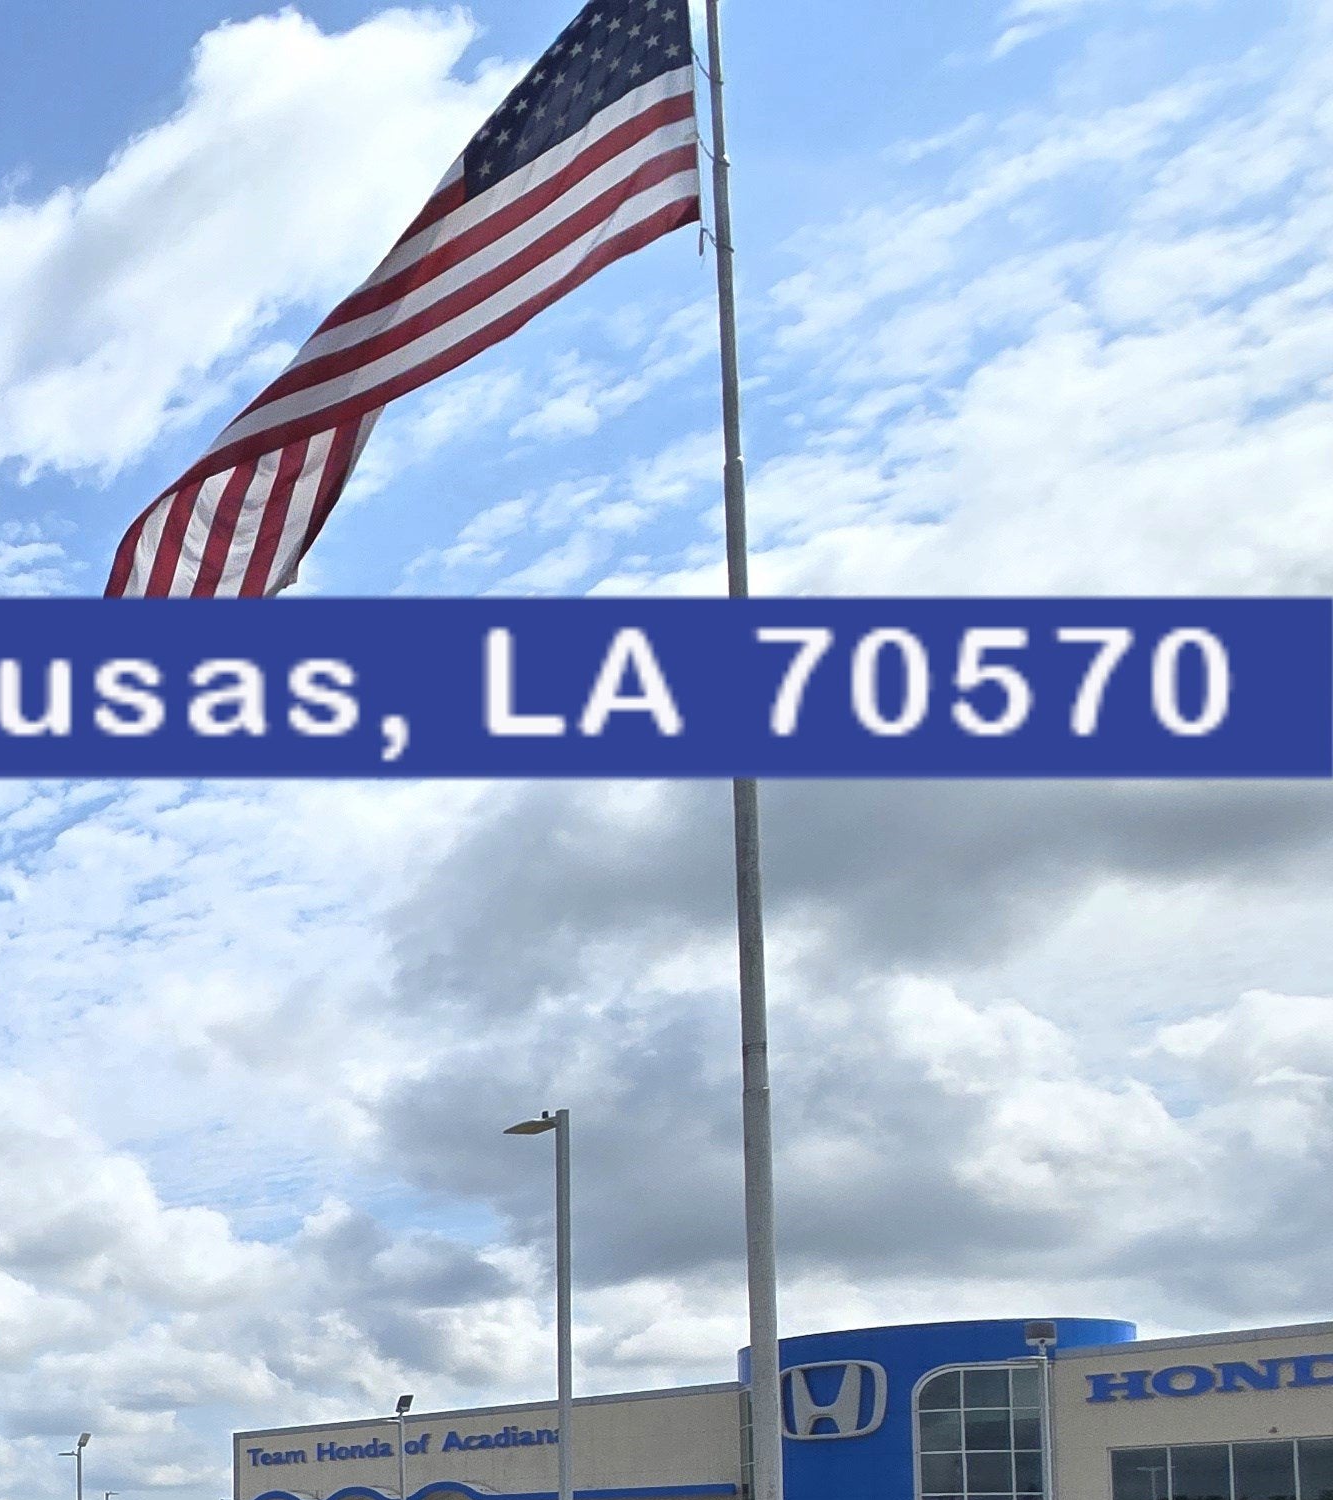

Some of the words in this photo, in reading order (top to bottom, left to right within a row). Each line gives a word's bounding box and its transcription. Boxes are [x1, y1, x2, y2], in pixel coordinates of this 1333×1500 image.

[247, 1448, 307, 1467] Team
[316, 1437, 394, 1462] Honda
[404, 1433, 431, 1455] of
